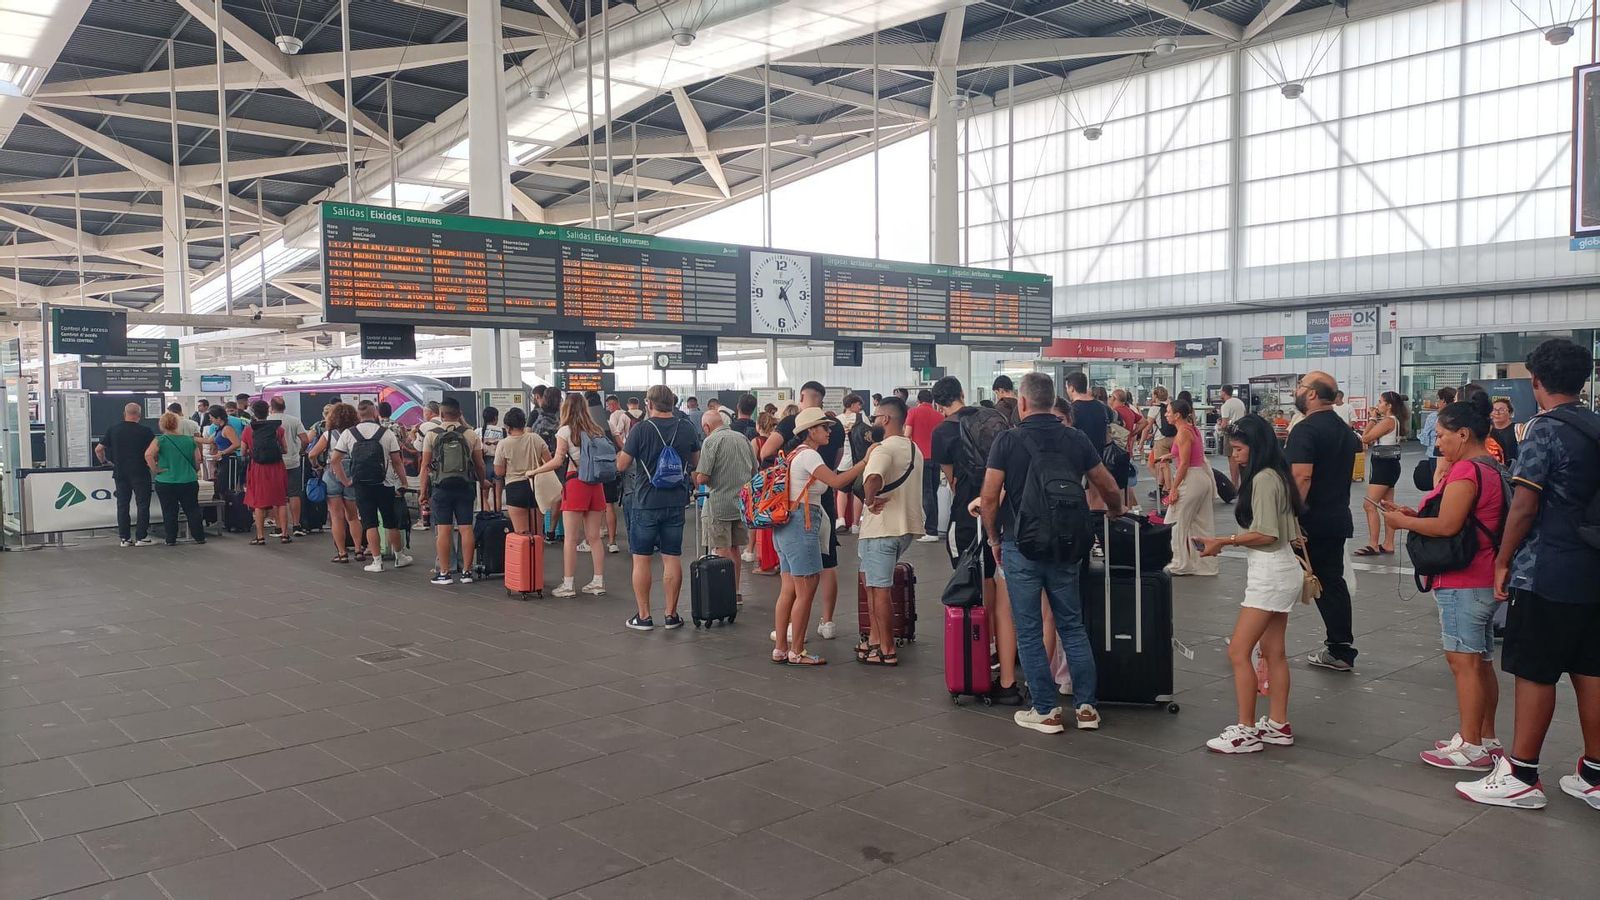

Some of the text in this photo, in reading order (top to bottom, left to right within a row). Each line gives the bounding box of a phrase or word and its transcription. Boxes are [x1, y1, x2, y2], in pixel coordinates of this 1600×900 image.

[332, 206, 442, 226] Salidas Eixides DEPARTURES
[566, 230, 650, 246] Salidas Eixides DEPARTURES
[1578, 238, 1600, 250] glob
[776, 260, 788, 271] 12
[756, 288, 764, 298] 9
[800, 290, 807, 300] 3
[1354, 312, 1376, 323] OK
[778, 318, 786, 328] 6
[164, 351, 172, 360] 4
[247, 374, 252, 382] 3
[165, 380, 173, 389] 4
[561, 381, 566, 389] 3
